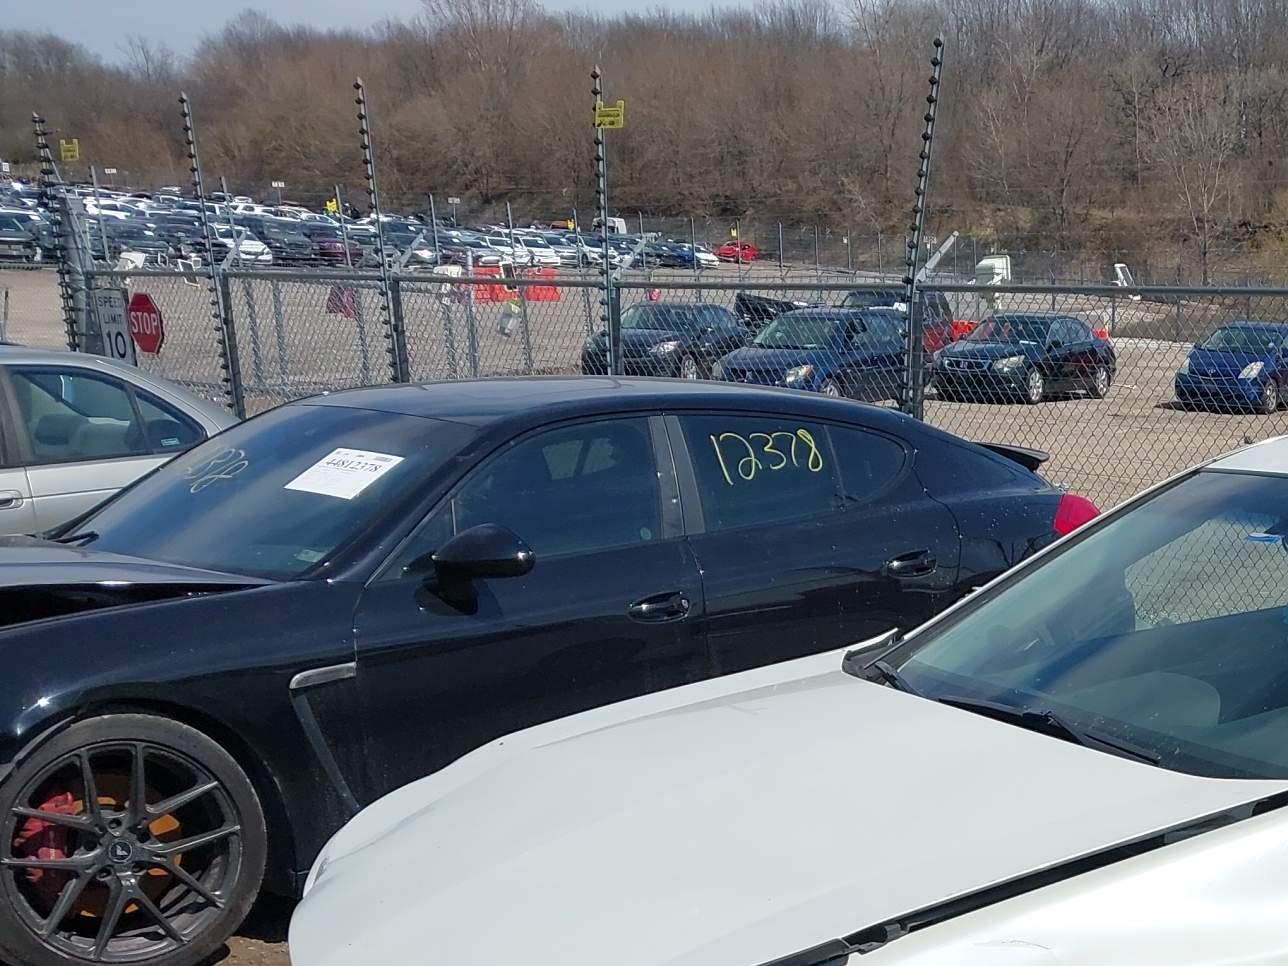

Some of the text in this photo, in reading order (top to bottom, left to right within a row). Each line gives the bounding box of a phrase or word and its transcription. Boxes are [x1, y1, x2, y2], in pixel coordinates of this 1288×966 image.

[130, 311, 158, 335] STOP
[106, 330, 127, 358] 10
[325, 457, 383, 474] 44812378
[709, 428, 823, 486] 12378
